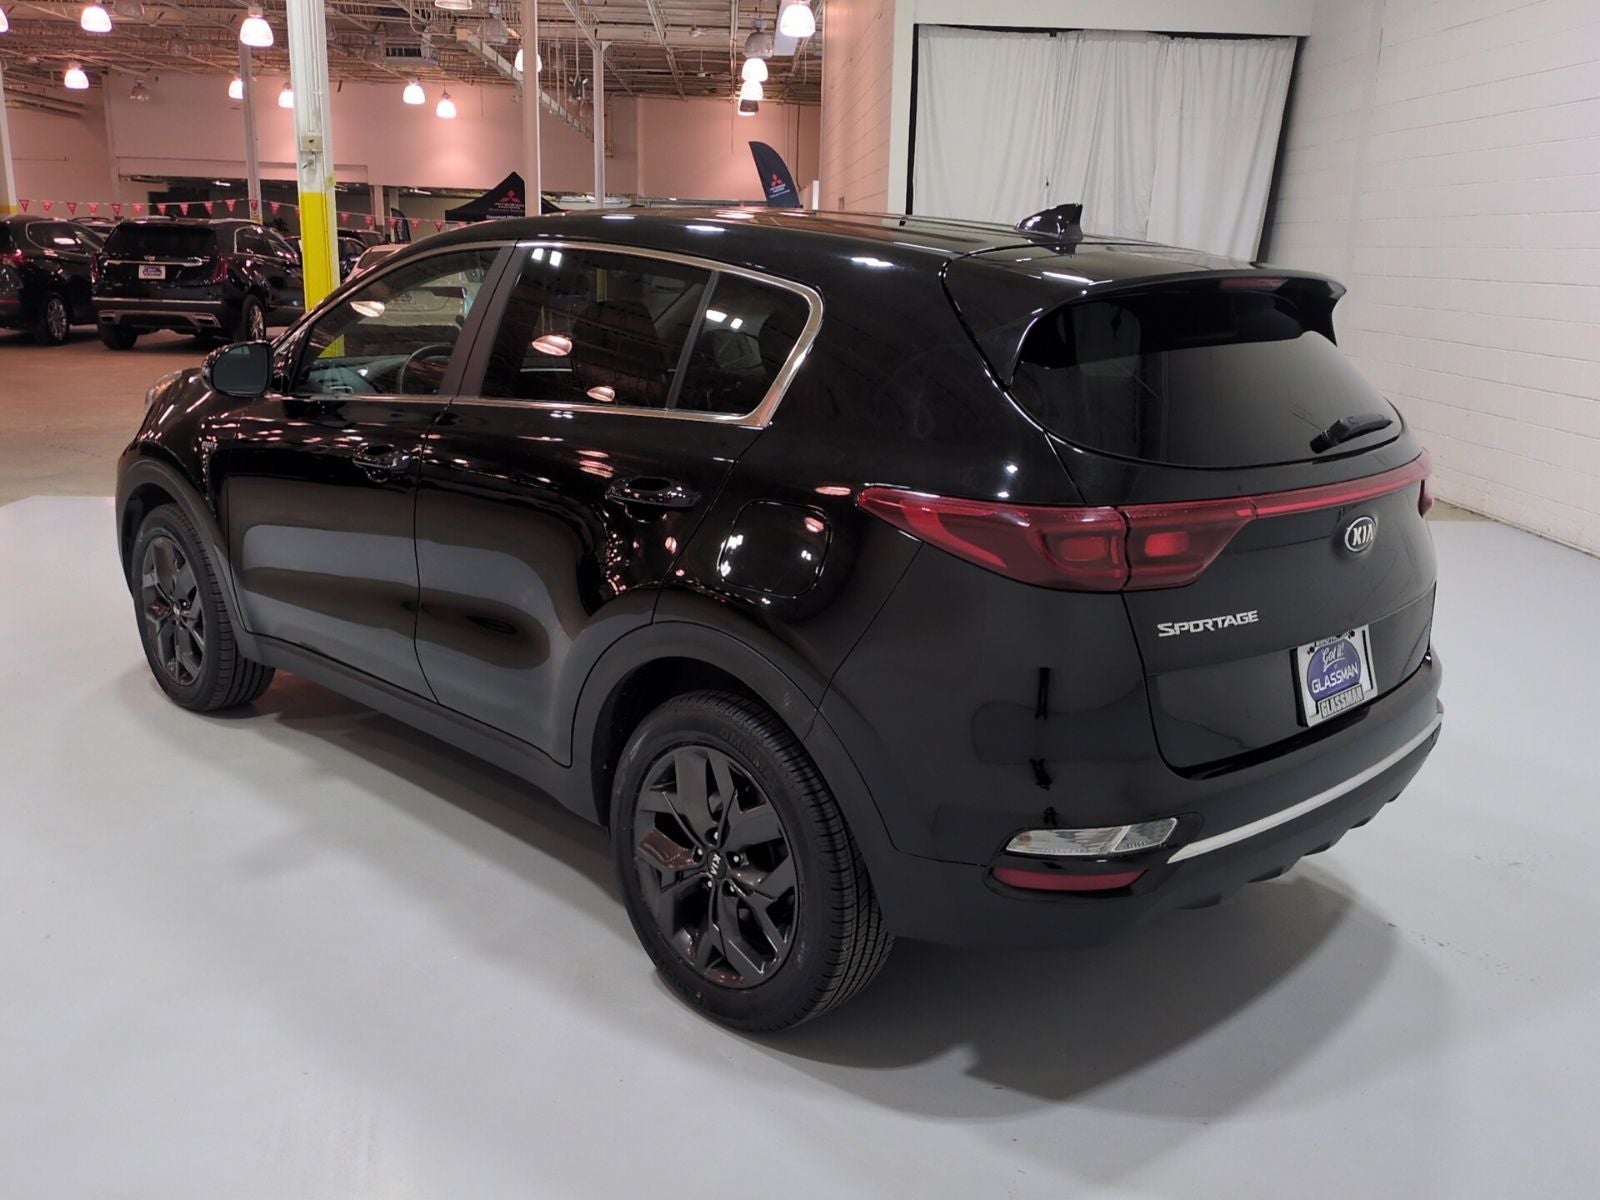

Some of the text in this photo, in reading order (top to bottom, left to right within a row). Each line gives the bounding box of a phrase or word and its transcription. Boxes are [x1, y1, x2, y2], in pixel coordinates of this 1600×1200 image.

[1352, 523, 1374, 546] KIA
[1157, 609, 1259, 637] SPORTAGE
[1311, 662, 1359, 694] GLASSMAN
[1321, 686, 1363, 716] GLASSMAN
[710, 853, 721, 875] KIA
